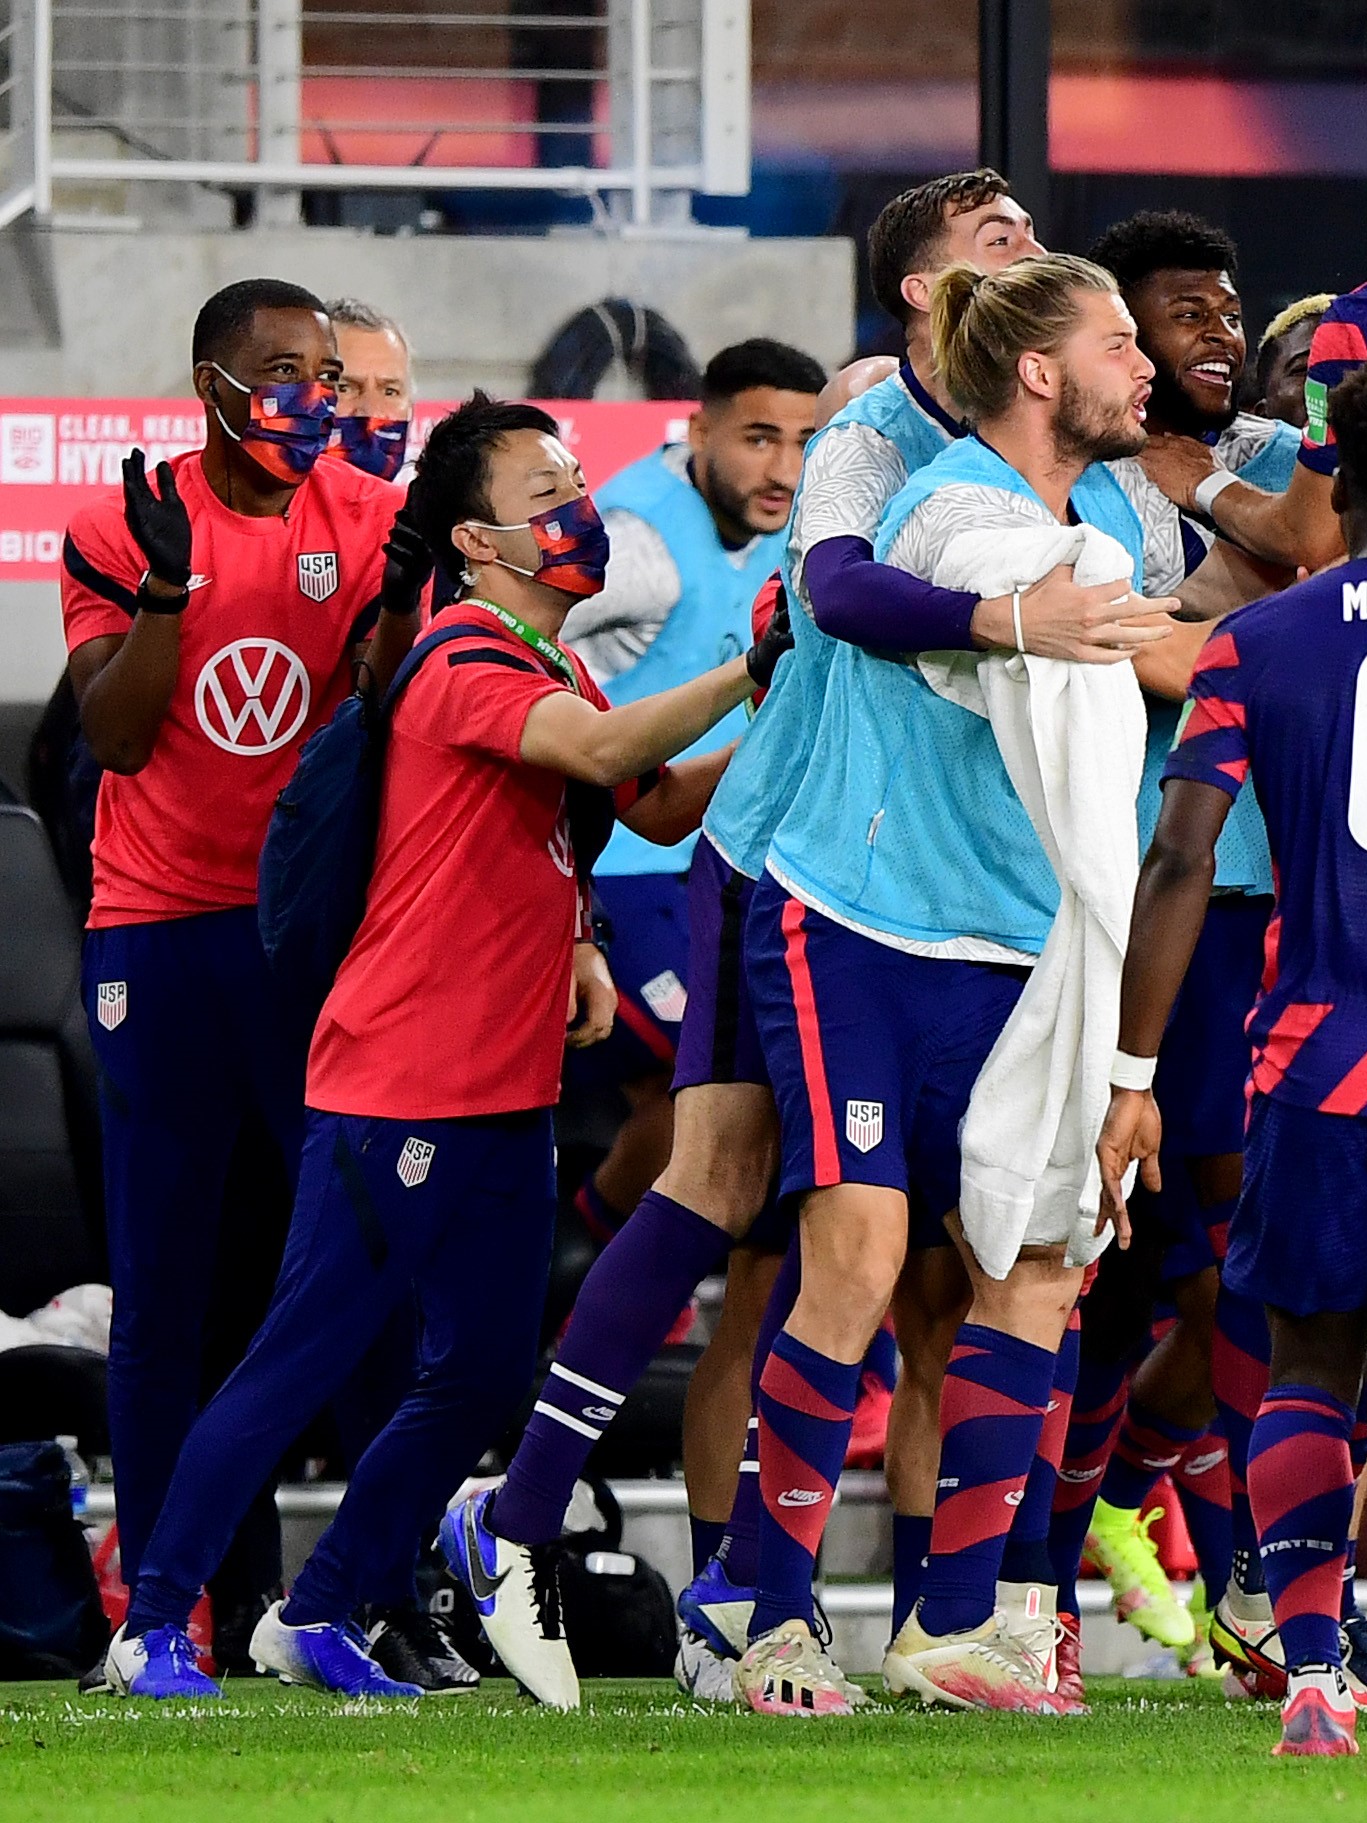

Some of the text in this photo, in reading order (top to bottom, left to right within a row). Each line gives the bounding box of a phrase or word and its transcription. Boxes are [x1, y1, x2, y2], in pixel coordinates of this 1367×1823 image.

[300, 555, 334, 575] USA
[195, 638, 310, 755] VW
[99, 984, 126, 1002] USA
[849, 1104, 881, 1123] USA
[406, 1139, 432, 1161] USA
[787, 1488, 824, 1502] NIKE
